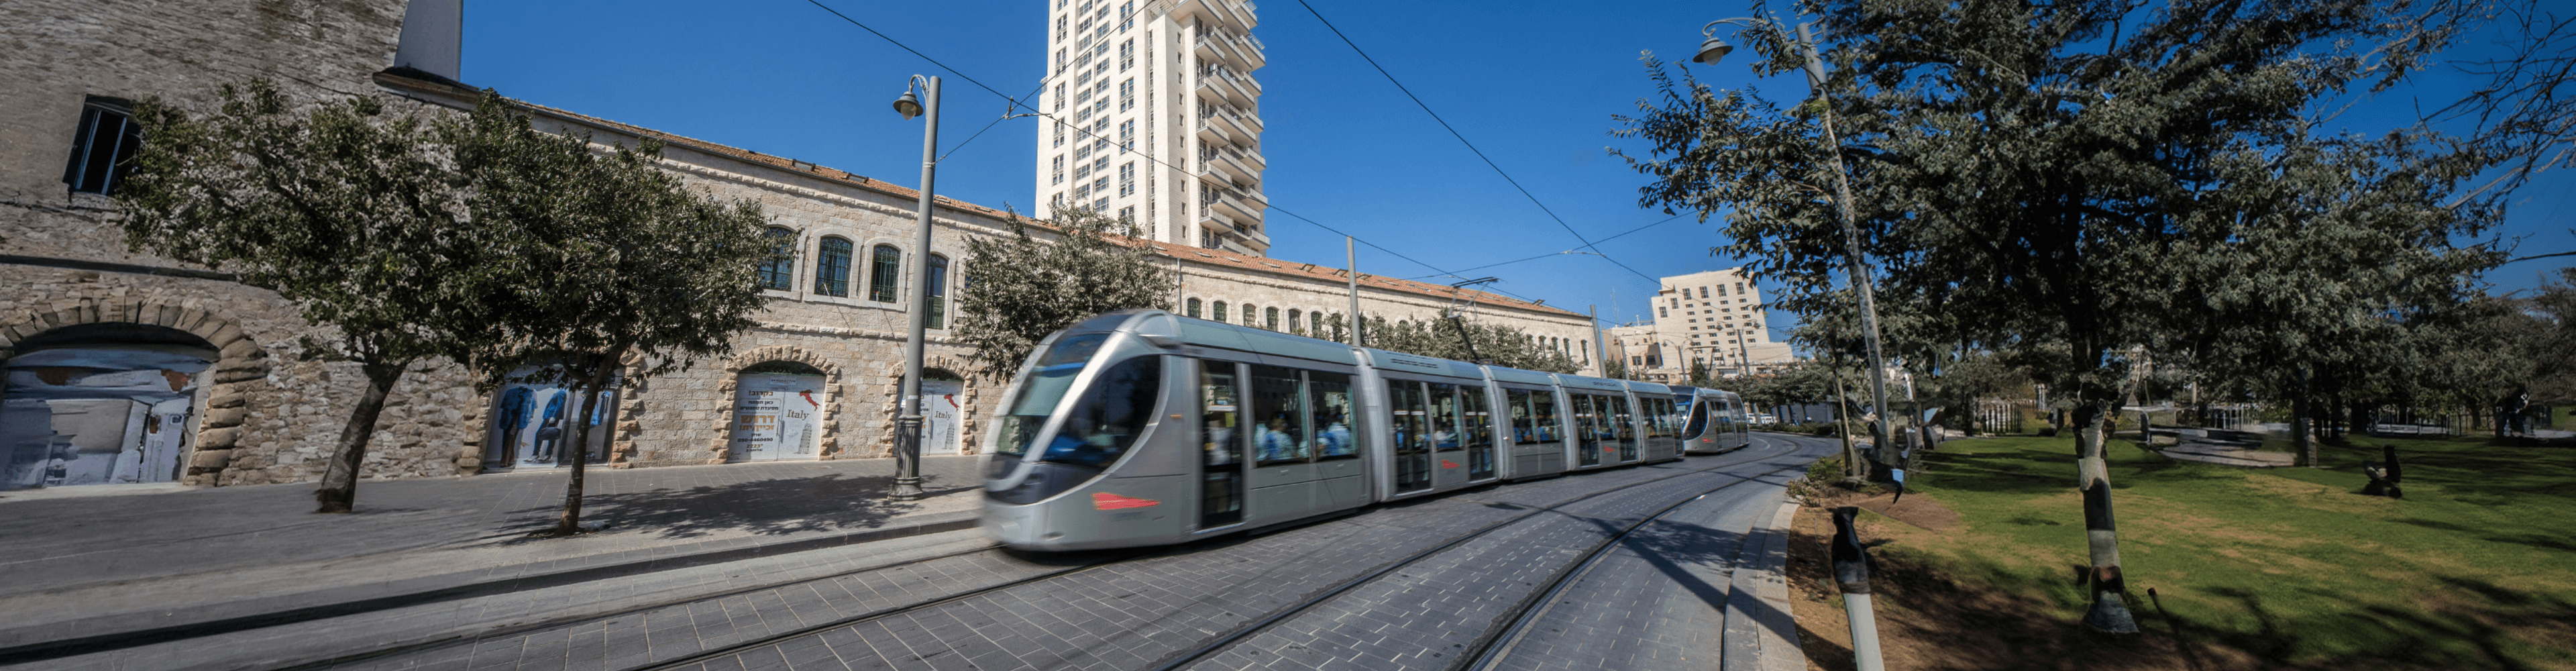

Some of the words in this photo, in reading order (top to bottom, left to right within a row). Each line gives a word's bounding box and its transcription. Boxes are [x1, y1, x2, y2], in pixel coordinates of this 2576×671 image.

[741, 415, 775, 423] דרוש
[786, 409, 809, 421] Italy
[934, 411, 952, 421] Italy
